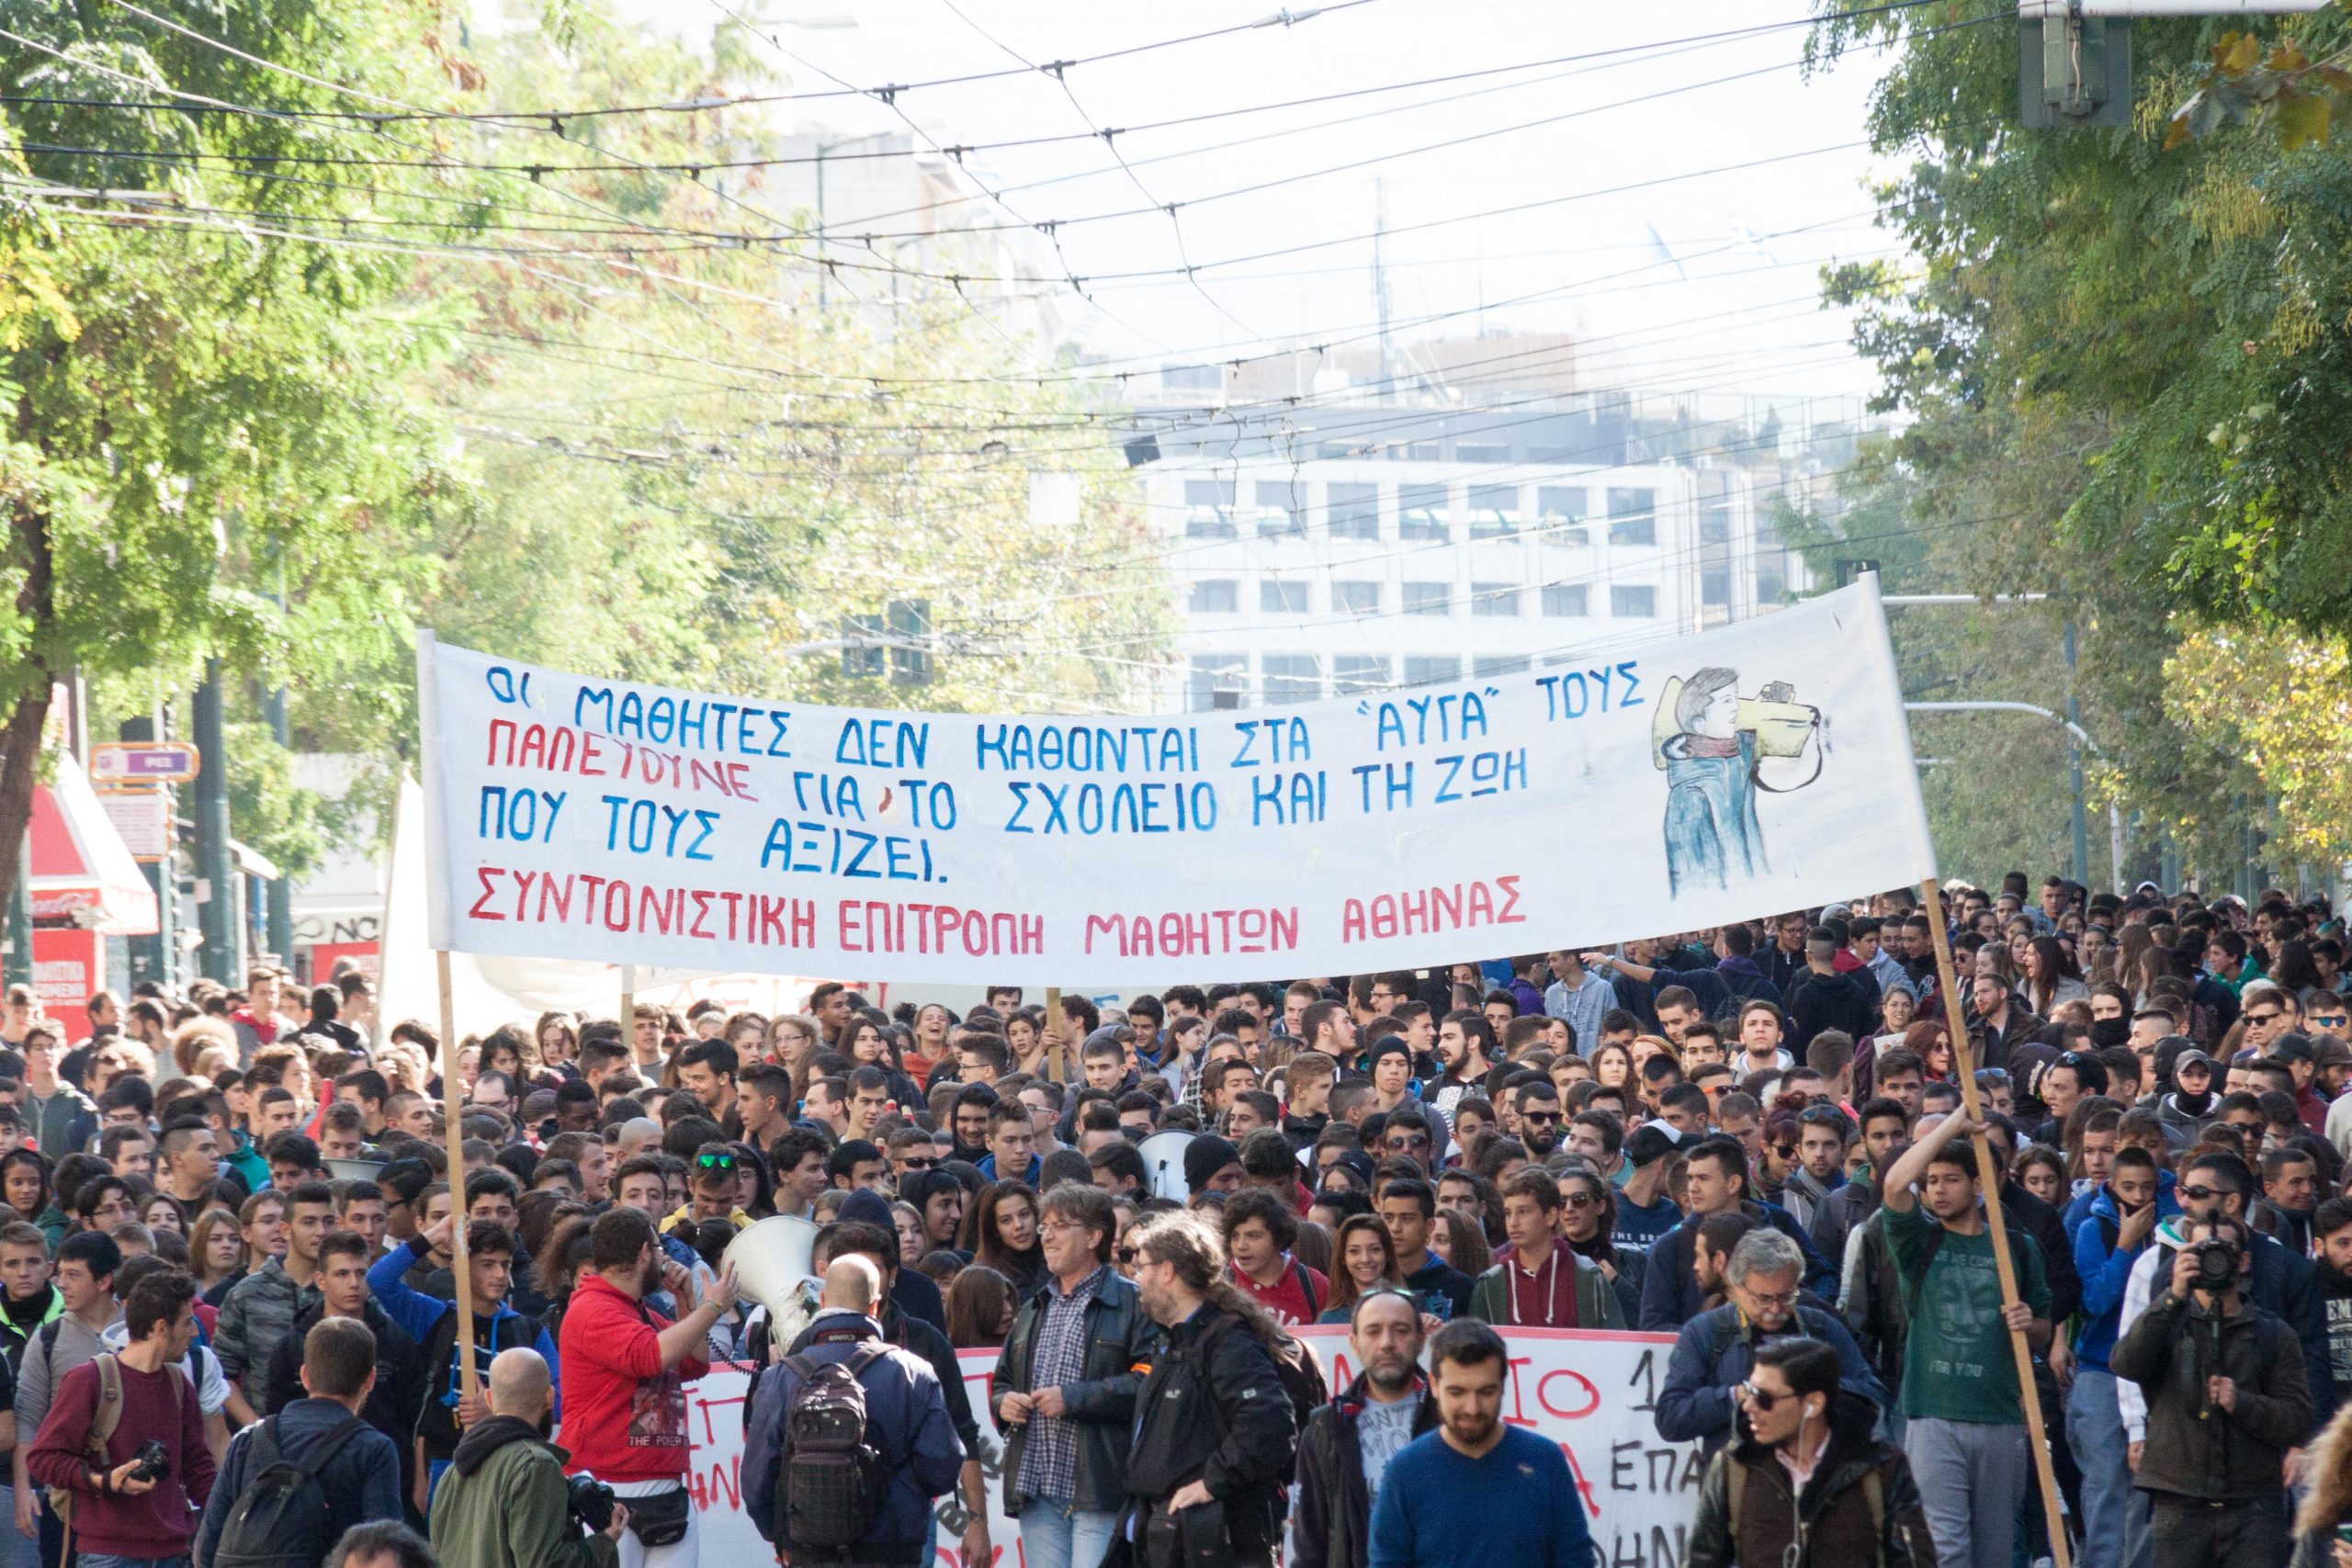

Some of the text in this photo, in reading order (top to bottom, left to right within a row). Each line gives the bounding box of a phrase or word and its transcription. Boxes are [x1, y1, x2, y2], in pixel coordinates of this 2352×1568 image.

[485, 666, 531, 707] ΟΙ
[573, 686, 793, 760] ΜΑΘΗΤΕΣ
[835, 716, 931, 770] ΔΕΝ
[976, 723, 1200, 773] ΚΑΘΟΝΤΑΙ
[1229, 716, 1312, 770] ΣΤΑ
[1534, 660, 1646, 722] ΤΟΥΣ
[487, 718, 1528, 836] ΠΑΛΕΥΟΥΝΕ ΓΙΑ ΤΟ ΣΧΟΛΕΙΟ ΚΑΙ ΤΗ ΖΩΗ
[479, 785, 949, 886] ΠΟΥ ΤΟΥΣ ΑΞΙΖΕΙ.
[469, 865, 1527, 958] ΣΥΝΤΟΝΙΣΤΙΚΗ ΕΠΙΤΡΟΠΗ ΜΑΘΗΤΩΝ ΑΘΗΝΑΣ
[628, 1435, 650, 1447] THE
